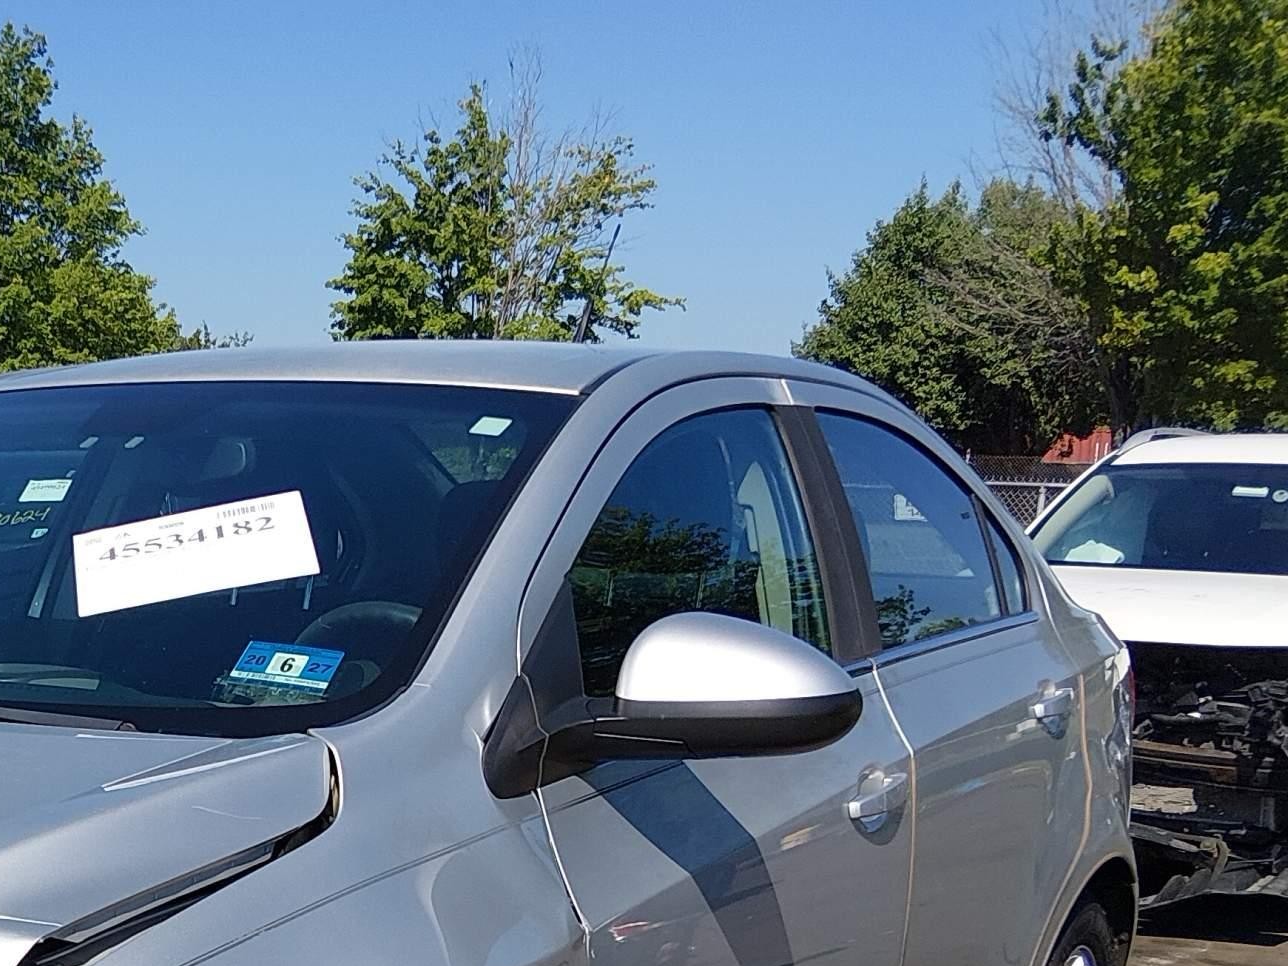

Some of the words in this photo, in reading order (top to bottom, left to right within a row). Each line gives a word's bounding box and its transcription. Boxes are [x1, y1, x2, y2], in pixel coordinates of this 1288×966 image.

[99, 517, 276, 561] 45534182
[244, 654, 267, 666] 20
[280, 657, 295, 673] 6
[309, 662, 332, 674] 27
